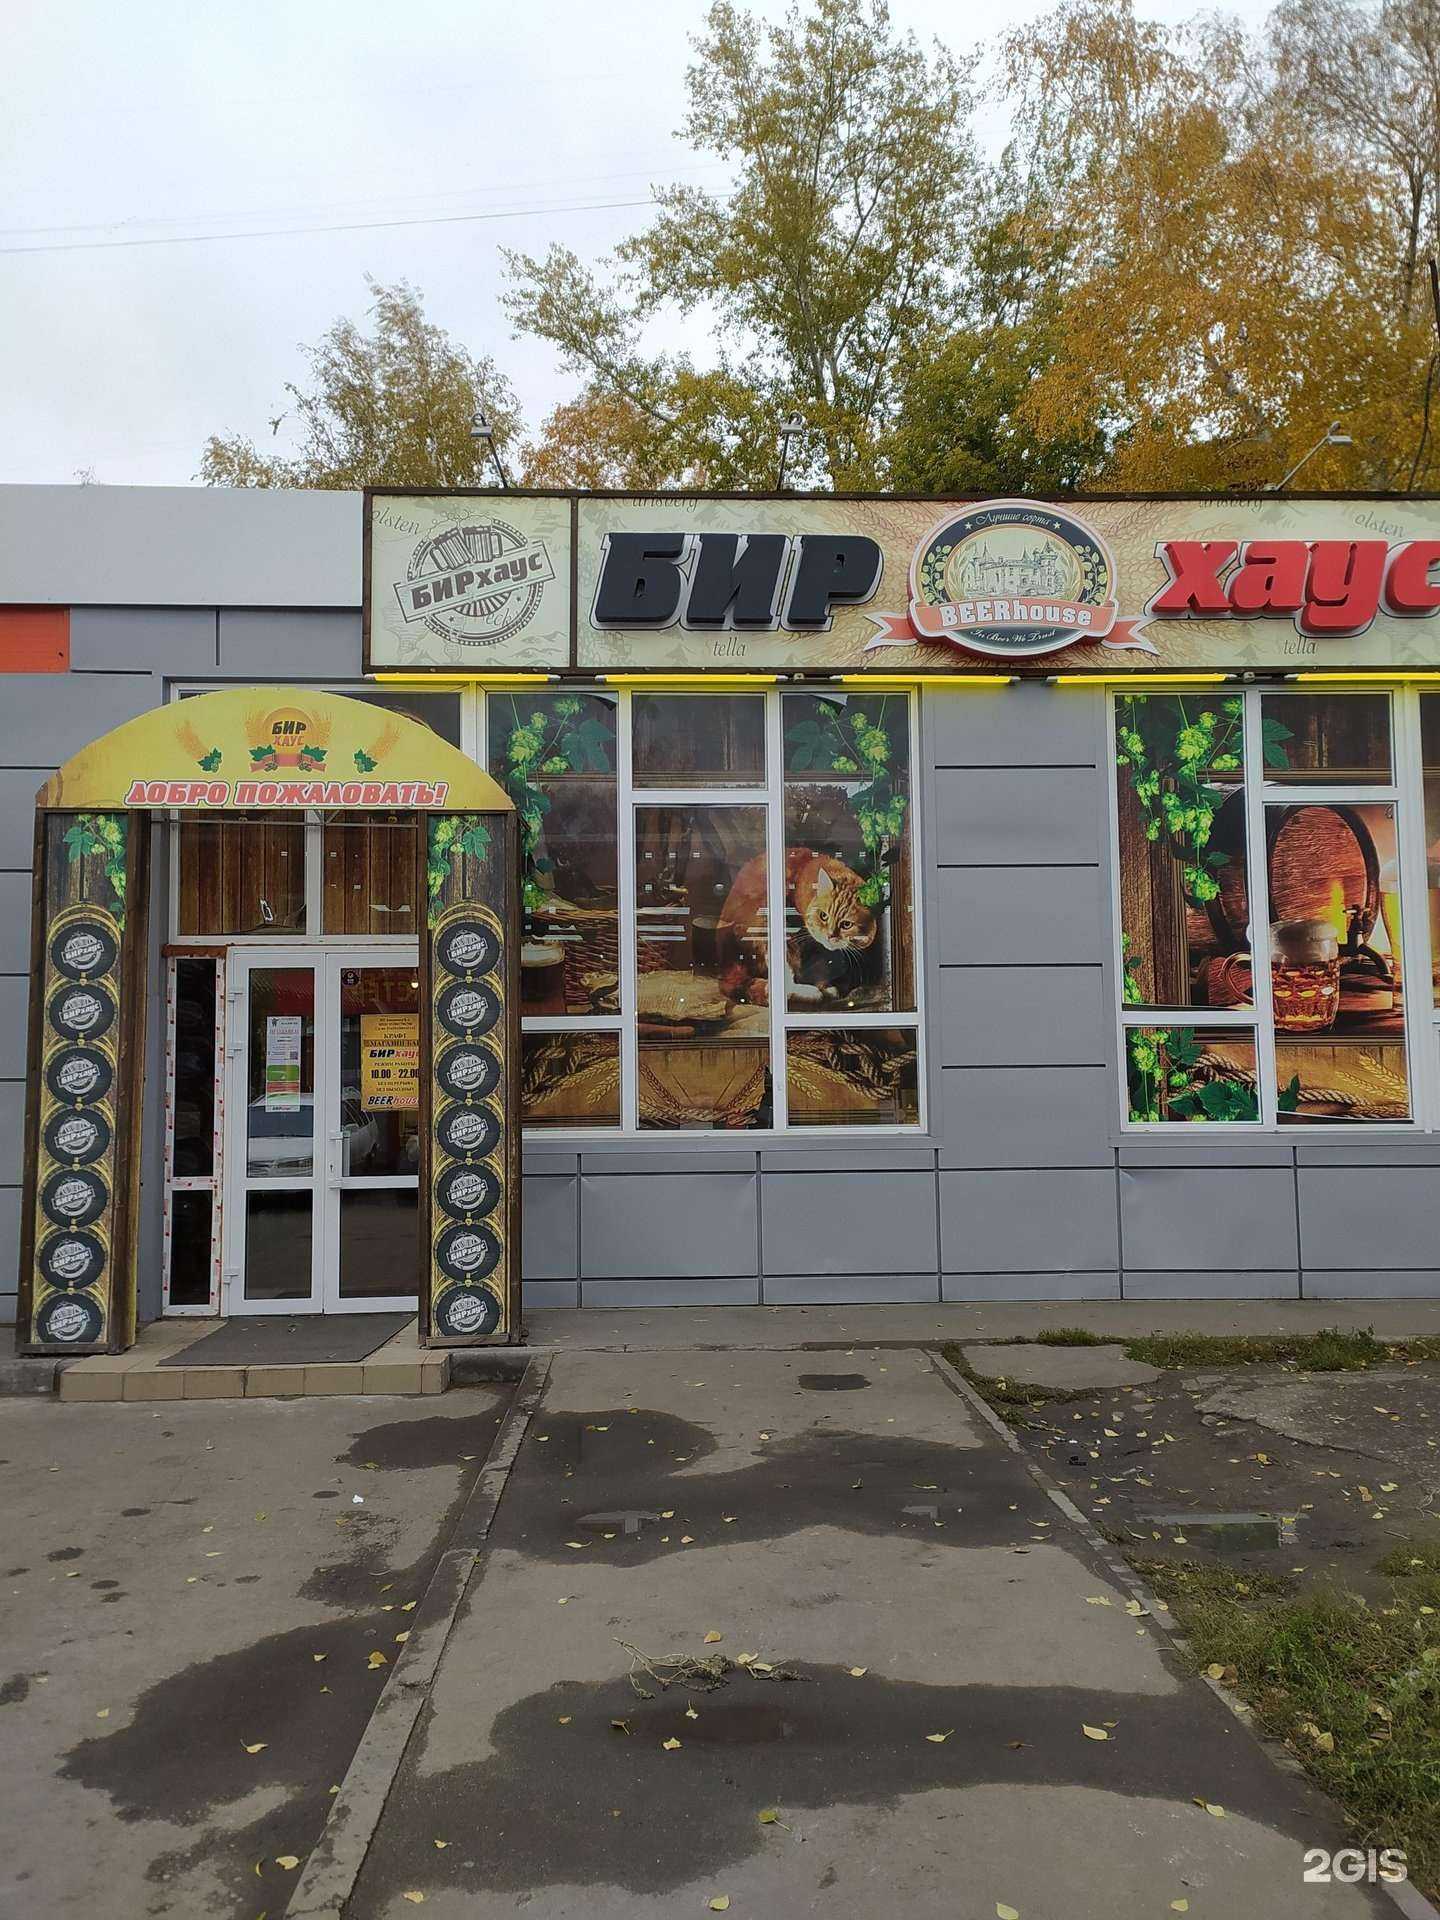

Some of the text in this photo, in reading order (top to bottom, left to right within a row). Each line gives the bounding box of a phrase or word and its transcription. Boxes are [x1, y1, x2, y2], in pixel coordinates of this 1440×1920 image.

[411, 552, 543, 610] БИРхаус
[590, 532, 884, 632] БИР
[939, 598, 1093, 627] BEERhouse
[271, 720, 307, 735] БИР
[125, 782, 449, 806] ДОБРО ПОЖАЛОВАТЬ!
